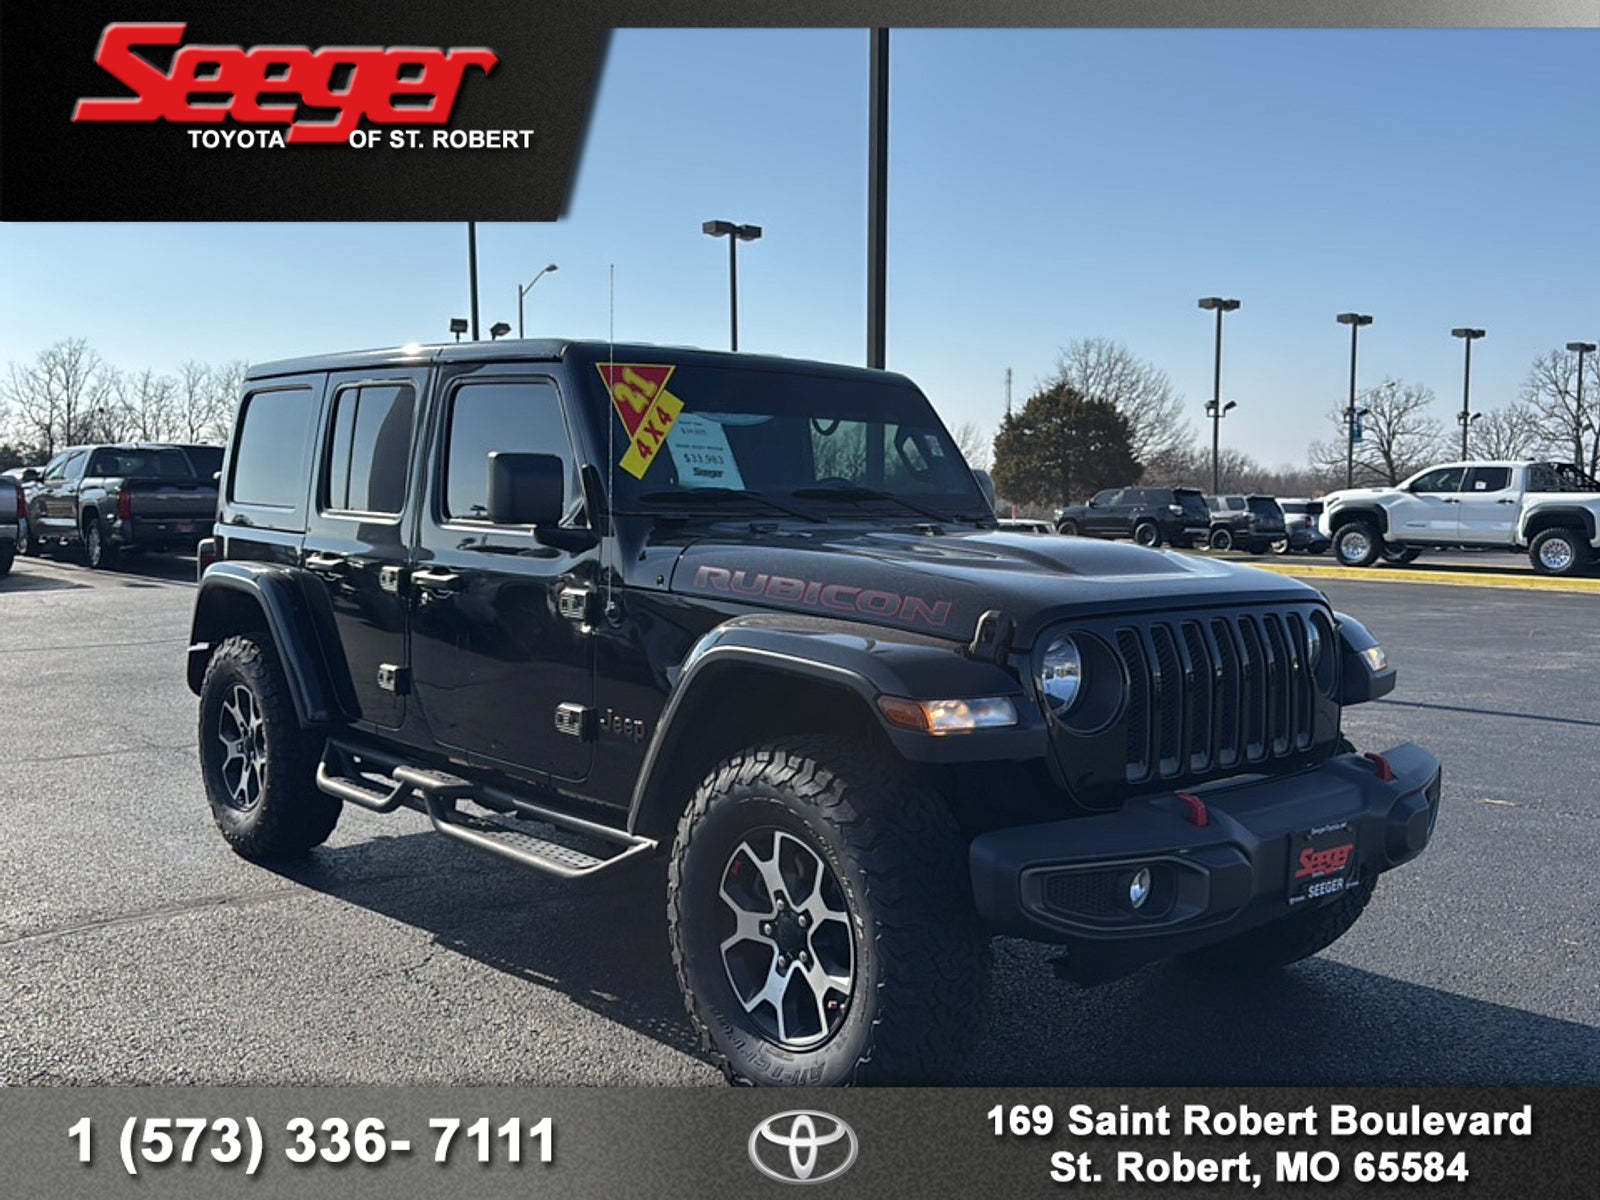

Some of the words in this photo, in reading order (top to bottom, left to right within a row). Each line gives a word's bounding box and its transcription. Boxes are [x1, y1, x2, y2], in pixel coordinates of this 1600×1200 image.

[612, 366, 658, 415] 21
[693, 566, 953, 626] RUBICON
[600, 707, 646, 745] Jeep
[1307, 878, 1345, 899] SEEGER
